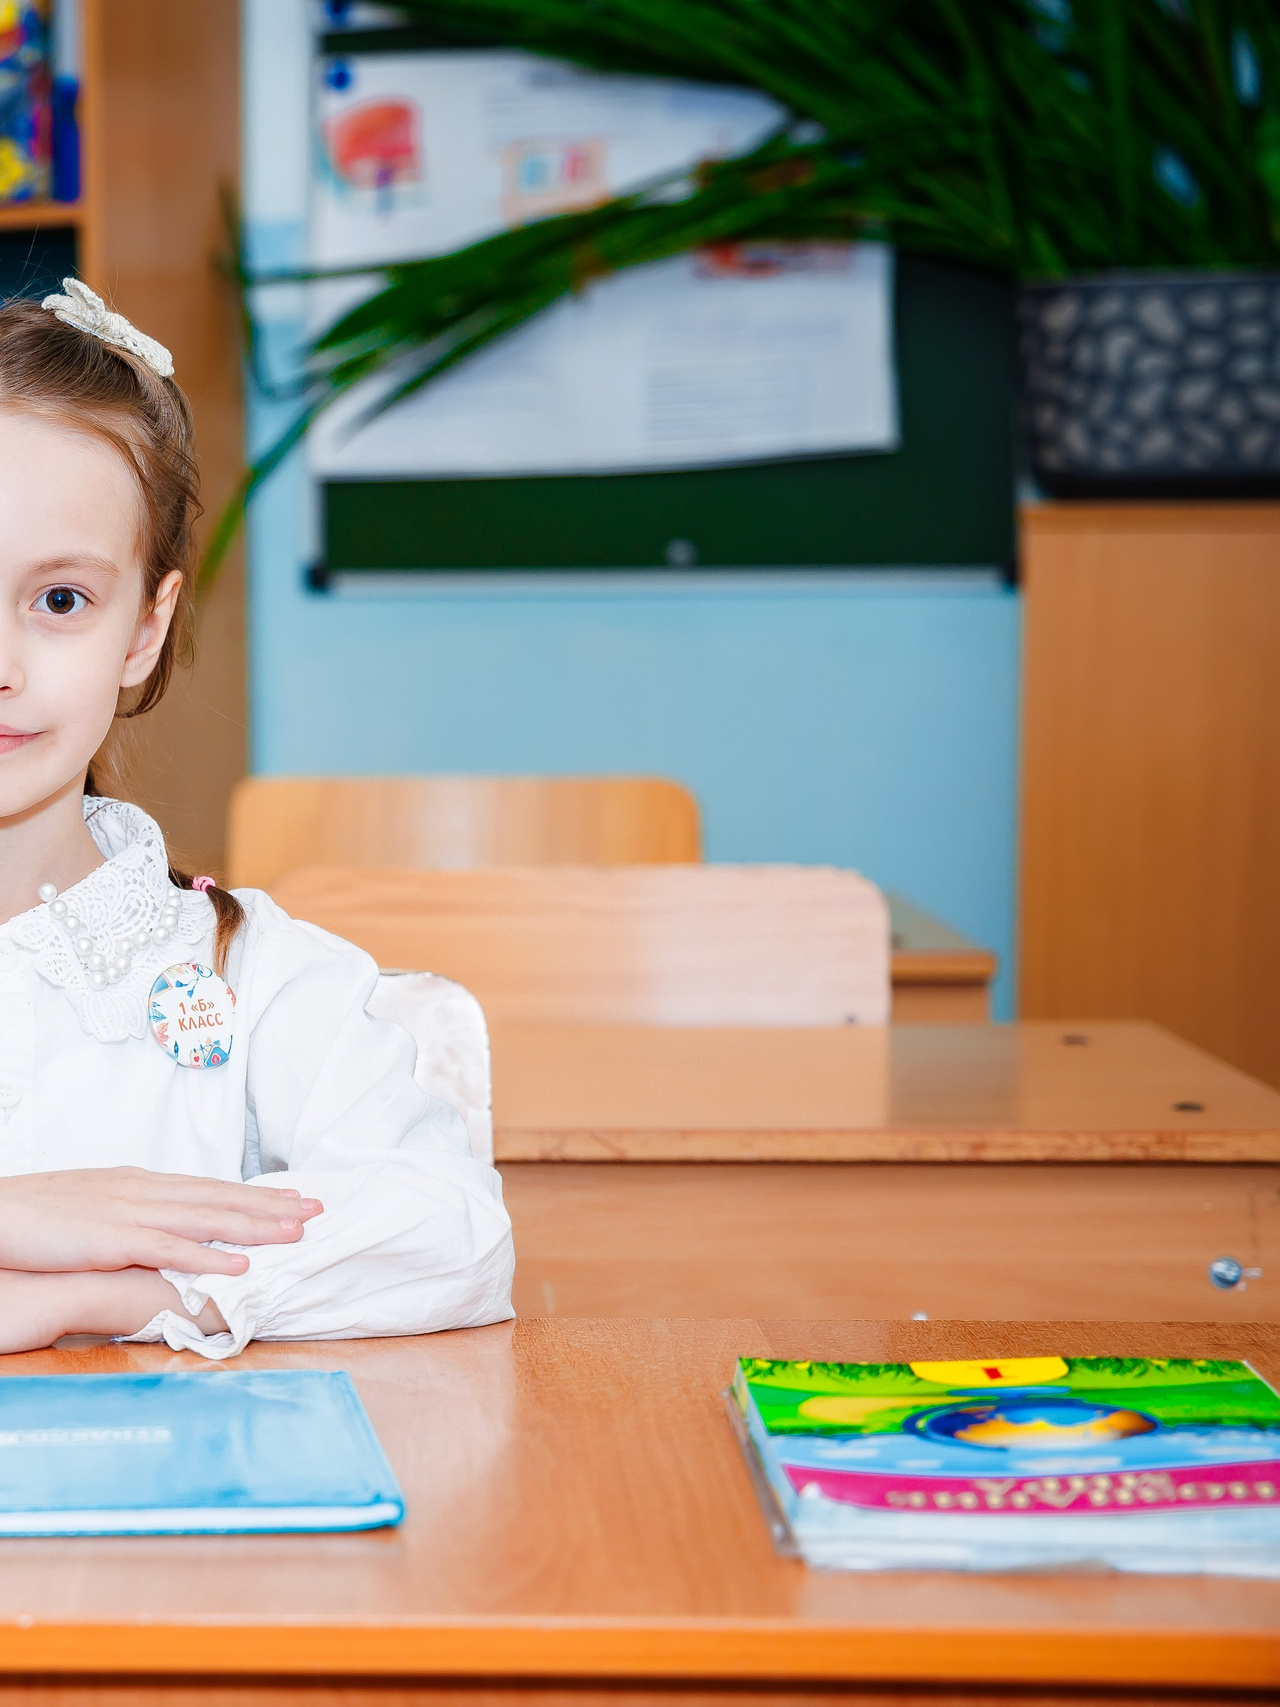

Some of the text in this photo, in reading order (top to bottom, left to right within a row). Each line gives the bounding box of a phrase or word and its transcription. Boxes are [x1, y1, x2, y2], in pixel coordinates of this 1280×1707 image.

[179, 998, 214, 1015] 1 «Б»
[178, 1013, 223, 1031] КЛАСС
